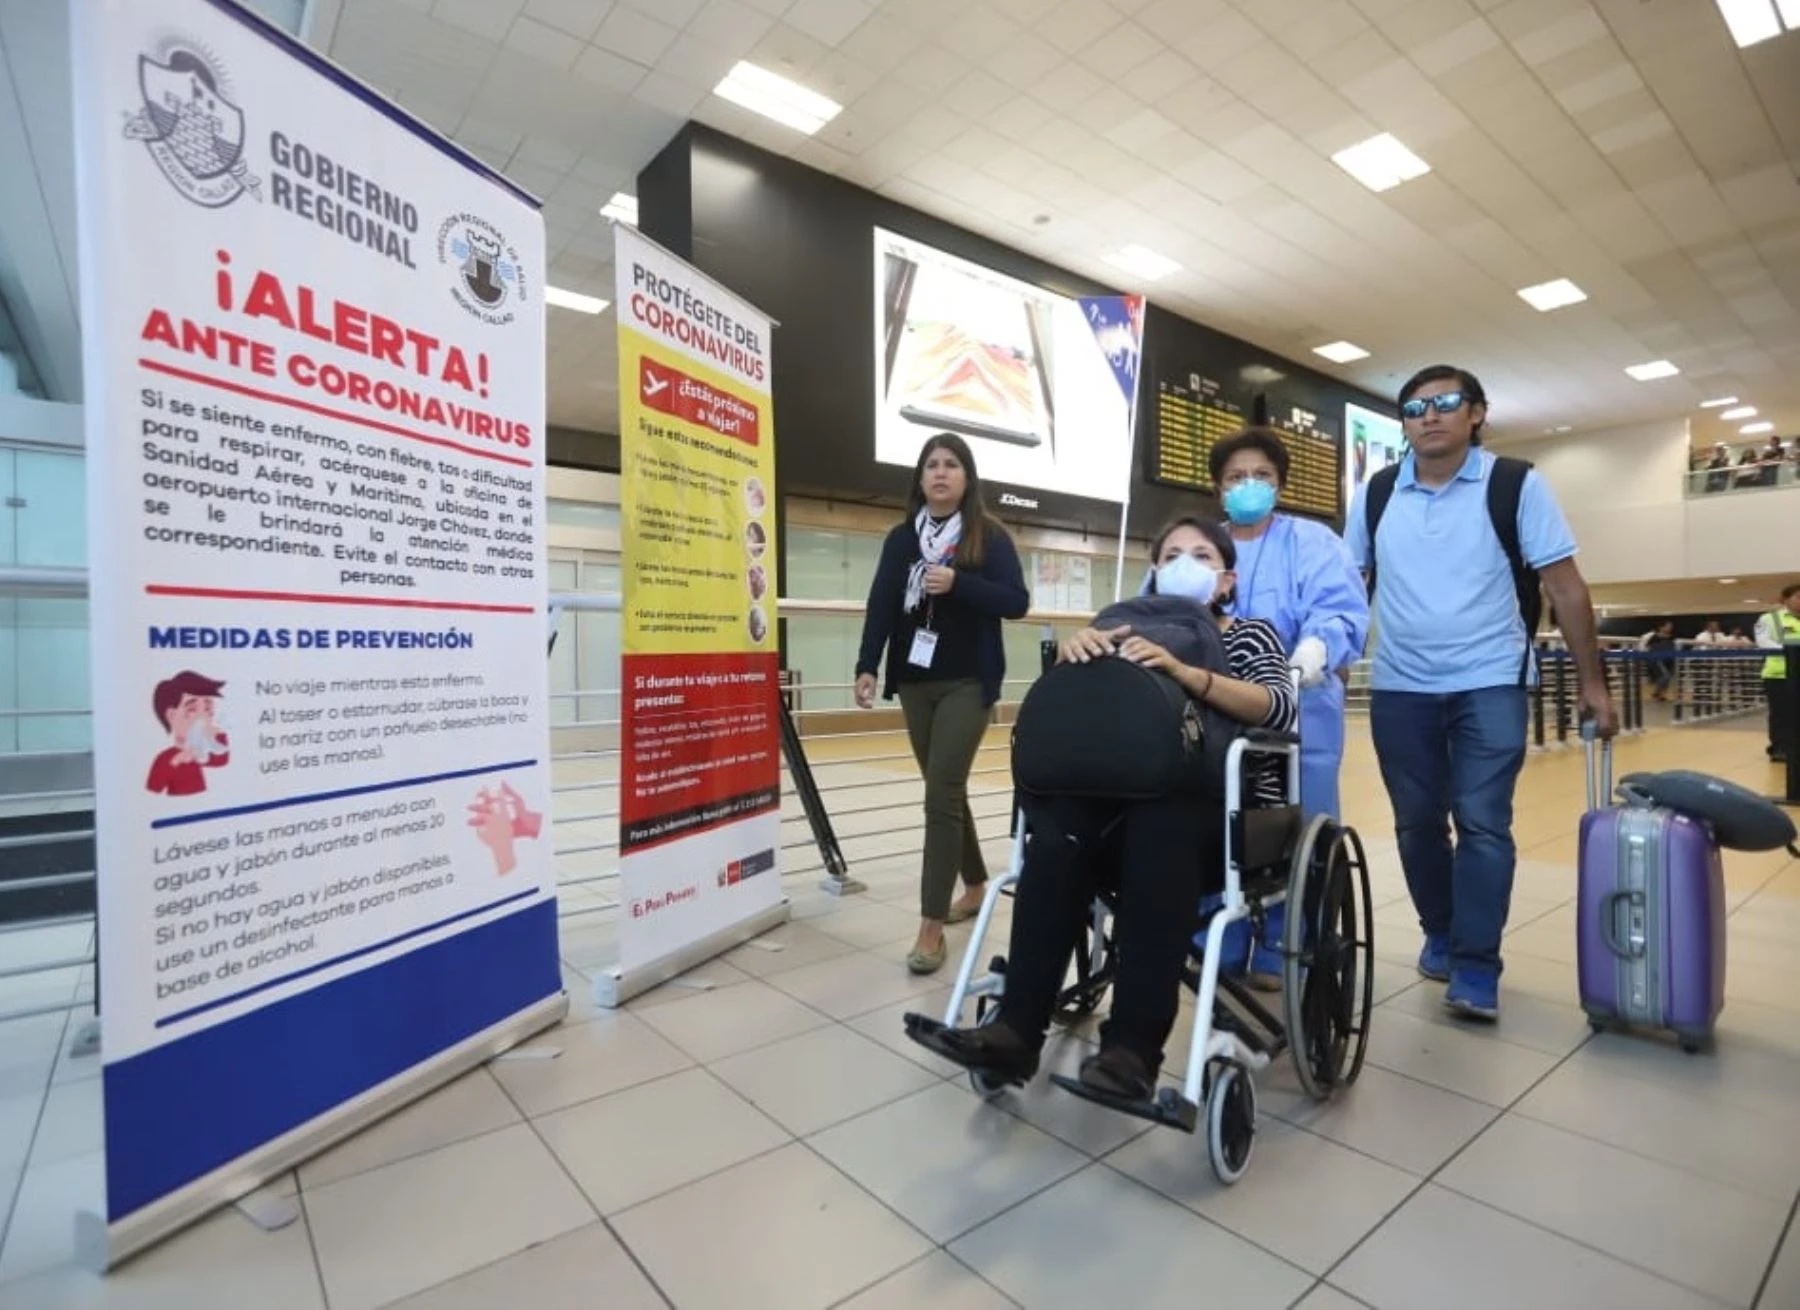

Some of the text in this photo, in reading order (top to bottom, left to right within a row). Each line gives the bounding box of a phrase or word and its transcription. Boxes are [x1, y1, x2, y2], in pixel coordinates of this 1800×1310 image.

[270, 130, 419, 233] GOBIERNO
[271, 174, 417, 270] REGIONAL
[216, 249, 489, 399] ¡ALERTA!
[631, 293, 764, 382] CORONAVIRUS
[633, 263, 762, 355] PROTÉGETE DEL
[141, 308, 532, 450] ANTE CORONAVIRUS
[141, 388, 163, 409] Si
[170, 399, 196, 416] se
[201, 405, 265, 433] siente
[271, 423, 352, 453] enfermo,
[356, 443, 386, 460] con
[390, 448, 434, 473] fiebre,
[438, 461, 459, 477] tos
[471, 469, 532, 492] dificultad
[142, 419, 199, 443] para
[220, 436, 305, 466] respirar,
[319, 456, 407, 485] acérquese
[440, 479, 454, 494] la
[464, 486, 507, 504] oficina
[517, 496, 532, 509] de
[143, 442, 239, 476] Sanidad
[255, 465, 314, 489] Aérea
[326, 480, 338, 496] y
[436, 500, 489, 520] ubicada
[498, 512, 513, 523] en
[521, 514, 532, 526] el
[143, 472, 533, 544] aeropuerto internacional Jorge Chávez, donde
[144, 499, 170, 515] se
[207, 503, 227, 523] le
[260, 511, 343, 538] brindará
[369, 527, 385, 542] la
[144, 526, 325, 558] correspondiente.
[334, 545, 377, 563] Evite
[384, 551, 398, 565] el
[405, 554, 468, 572] contacto
[340, 570, 416, 587] personas.
[149, 626, 473, 650] MEDIDAS DE PREVENCIÓN
[256, 680, 282, 696] No
[285, 678, 326, 697] viaje
[330, 678, 399, 692] mientras
[258, 708, 276, 724] Al
[280, 708, 325, 724] toser
[328, 708, 339, 720] o
[258, 732, 276, 750] la
[280, 729, 323, 746] nariz
[327, 728, 357, 742] con
[360, 727, 380, 738] un
[259, 759, 290, 775] use
[293, 754, 320, 768] las
[153, 797, 436, 864] Lávese las manos a menudo con
[154, 812, 445, 891] agua y jabón durante al menos 20
[156, 923, 175, 946] Si
[181, 919, 209, 937] no
[213, 907, 254, 929] hay
[257, 892, 305, 917] agua
[309, 889, 320, 904] y
[323, 875, 370, 901] jabón
[156, 872, 454, 973] use un desinfectante para manos a
[157, 970, 211, 1000] base
[215, 960, 243, 980] de
